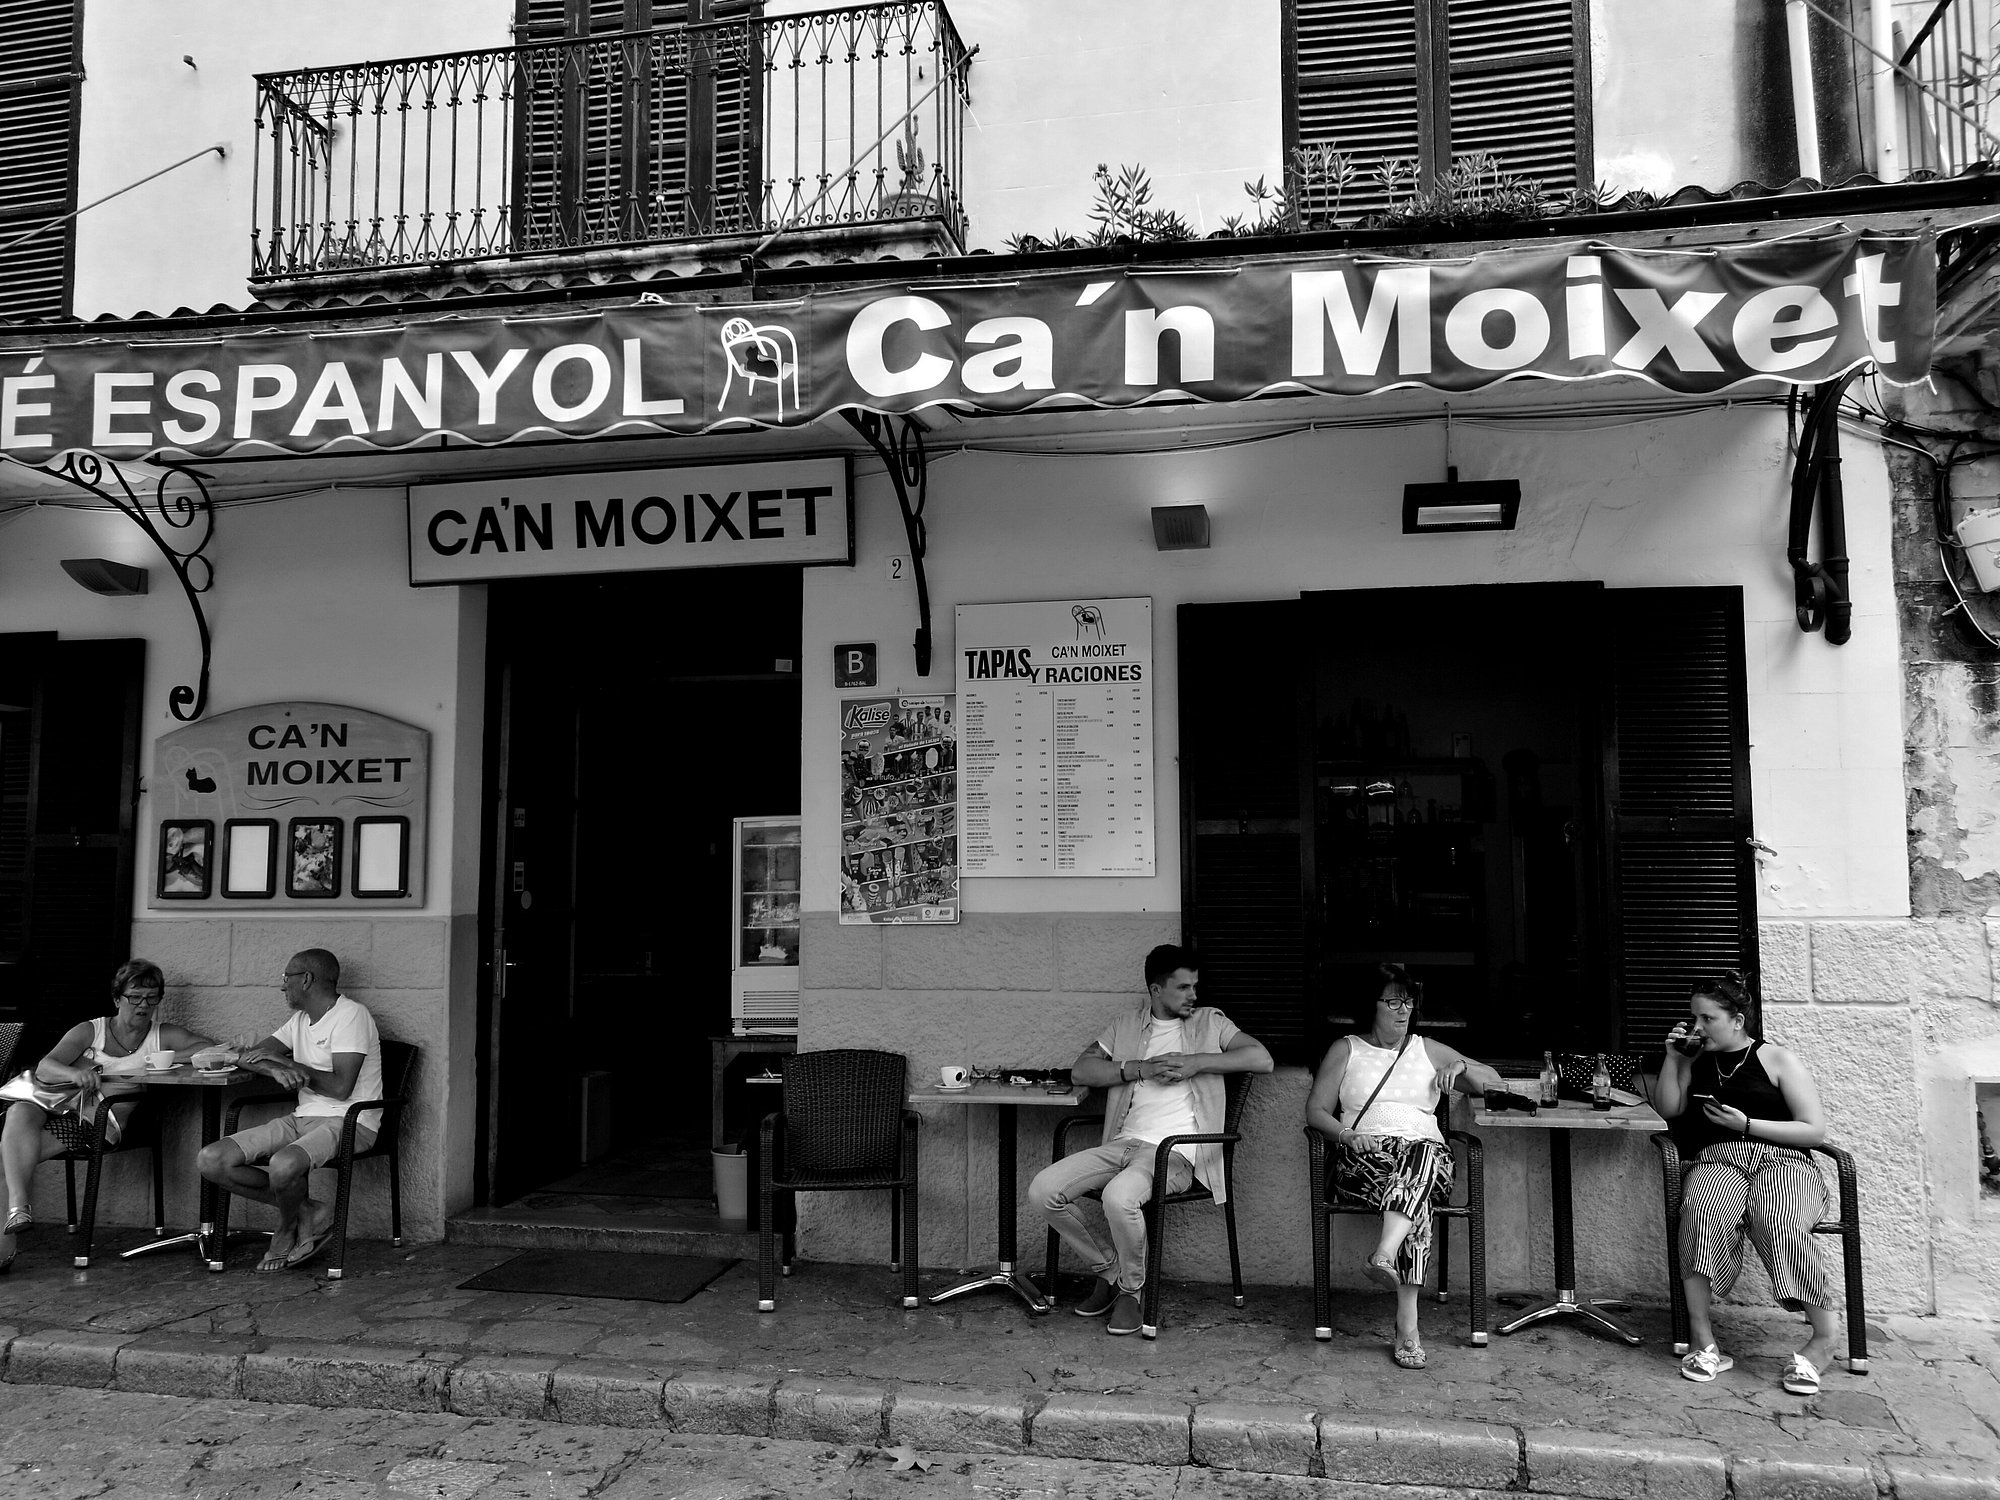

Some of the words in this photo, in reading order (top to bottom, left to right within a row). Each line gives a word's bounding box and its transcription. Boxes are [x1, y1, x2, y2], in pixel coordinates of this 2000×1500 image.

[1291, 251, 1902, 379] Moixet
[92, 337, 686, 448] ESPANYOL
[427, 496, 554, 556] CA'N
[576, 486, 833, 549] MOIXET
[892, 559, 902, 580] 2
[848, 650, 864, 674] B
[964, 648, 1031, 680] TAPAS
[1081, 643, 1127, 658] MOIXET
[1030, 668, 1041, 684] Y
[1045, 664, 1142, 683] RACIONES
[849, 704, 891, 729] Kalise
[247, 722, 348, 750] CA'N
[247, 757, 412, 785] MOIXET
